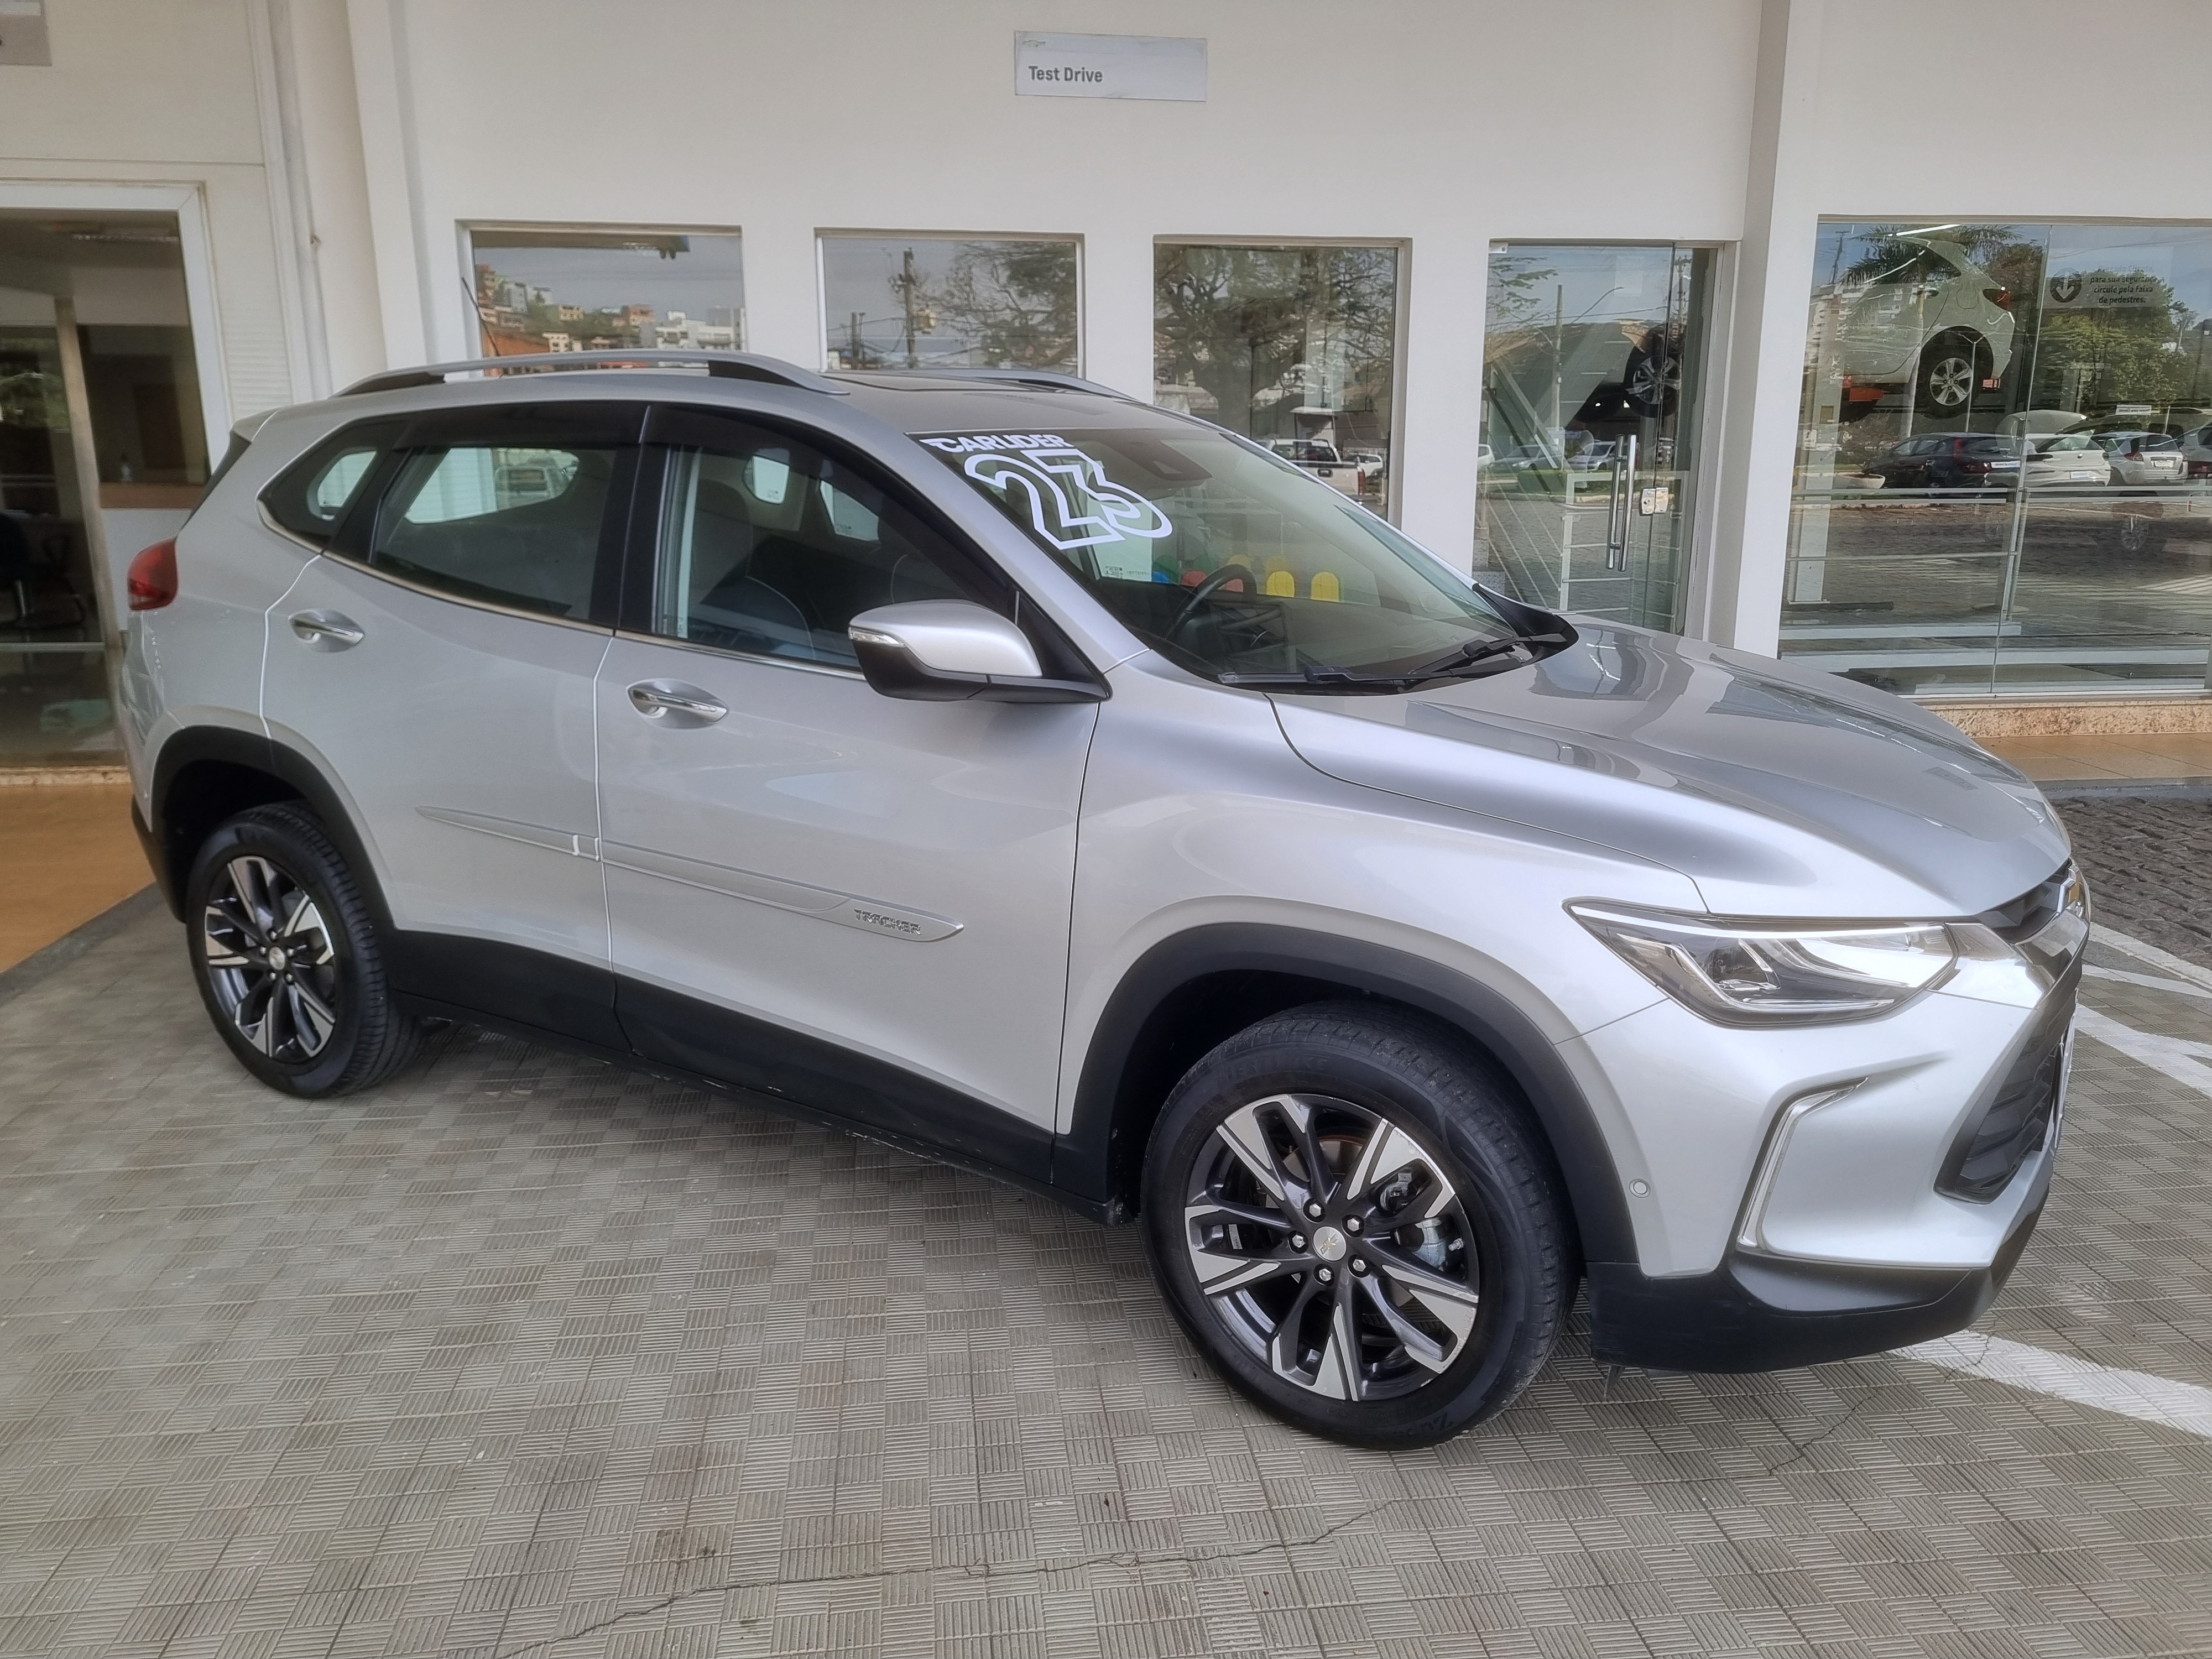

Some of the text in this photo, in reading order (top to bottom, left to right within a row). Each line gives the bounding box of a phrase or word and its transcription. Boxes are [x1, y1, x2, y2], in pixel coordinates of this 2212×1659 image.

[1028, 65, 1103, 82] Test Drive
[2090, 276, 2106, 285] para
[2119, 285, 2133, 294] pela
[2109, 296, 2146, 305] pedestres.
[964, 448, 1173, 550] 23
[854, 908, 921, 935] TRACKER
